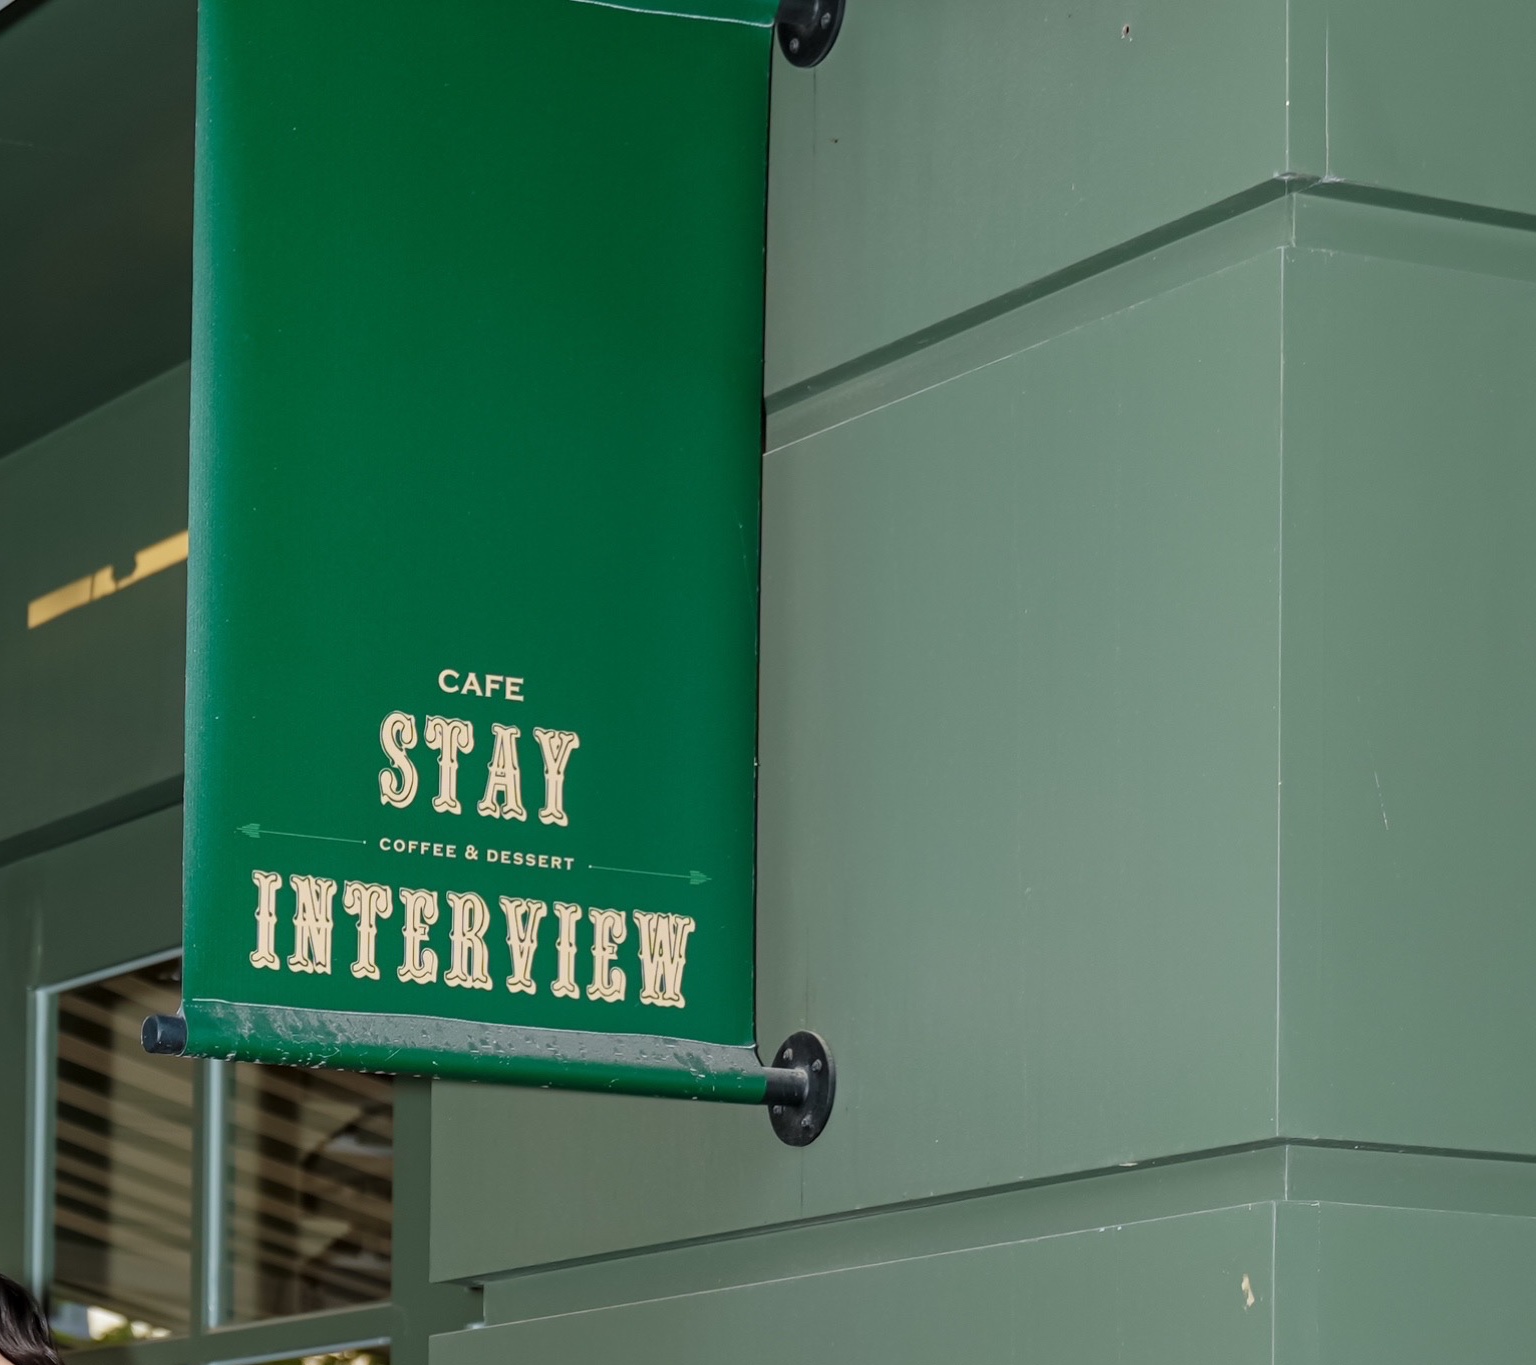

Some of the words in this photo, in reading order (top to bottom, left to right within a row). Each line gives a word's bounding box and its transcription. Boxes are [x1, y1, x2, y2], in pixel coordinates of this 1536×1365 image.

[438, 669, 524, 702] CAFE
[378, 710, 580, 827] STAY
[379, 838, 457, 858] COFFEE
[465, 845, 479, 861] &
[487, 850, 575, 871] DESSERT
[249, 869, 696, 1009] INTERVIEW
